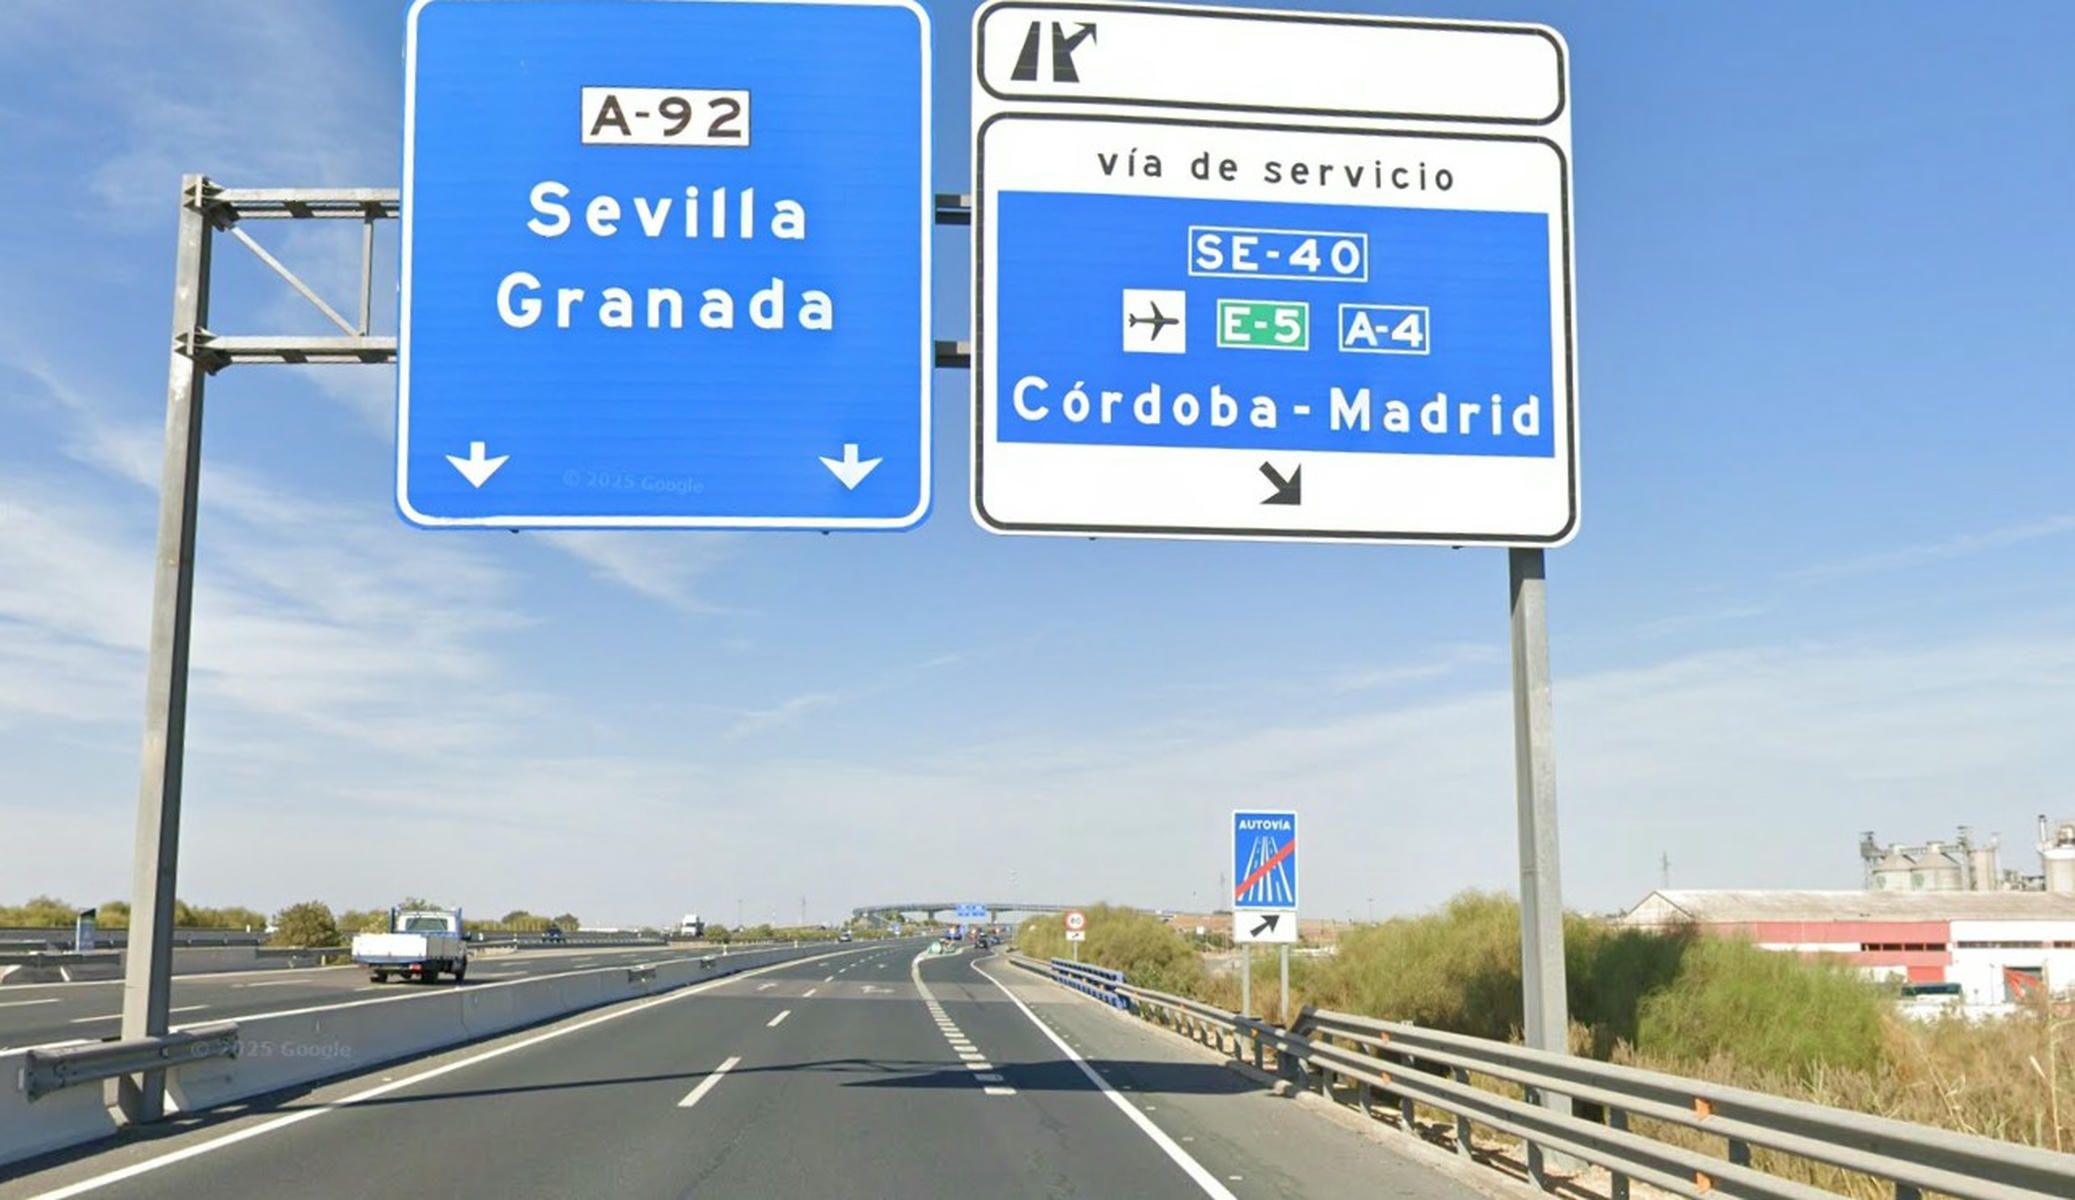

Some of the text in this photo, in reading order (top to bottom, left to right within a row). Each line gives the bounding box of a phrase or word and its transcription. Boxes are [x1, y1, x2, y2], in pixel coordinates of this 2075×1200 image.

[590, 94, 742, 137] A-92
[1097, 148, 1454, 191] vía de servicio
[527, 181, 806, 239] Sevilla
[1196, 234, 1361, 275] SE-40
[496, 271, 833, 330] Granada
[1223, 306, 1423, 347] E-5 A-4
